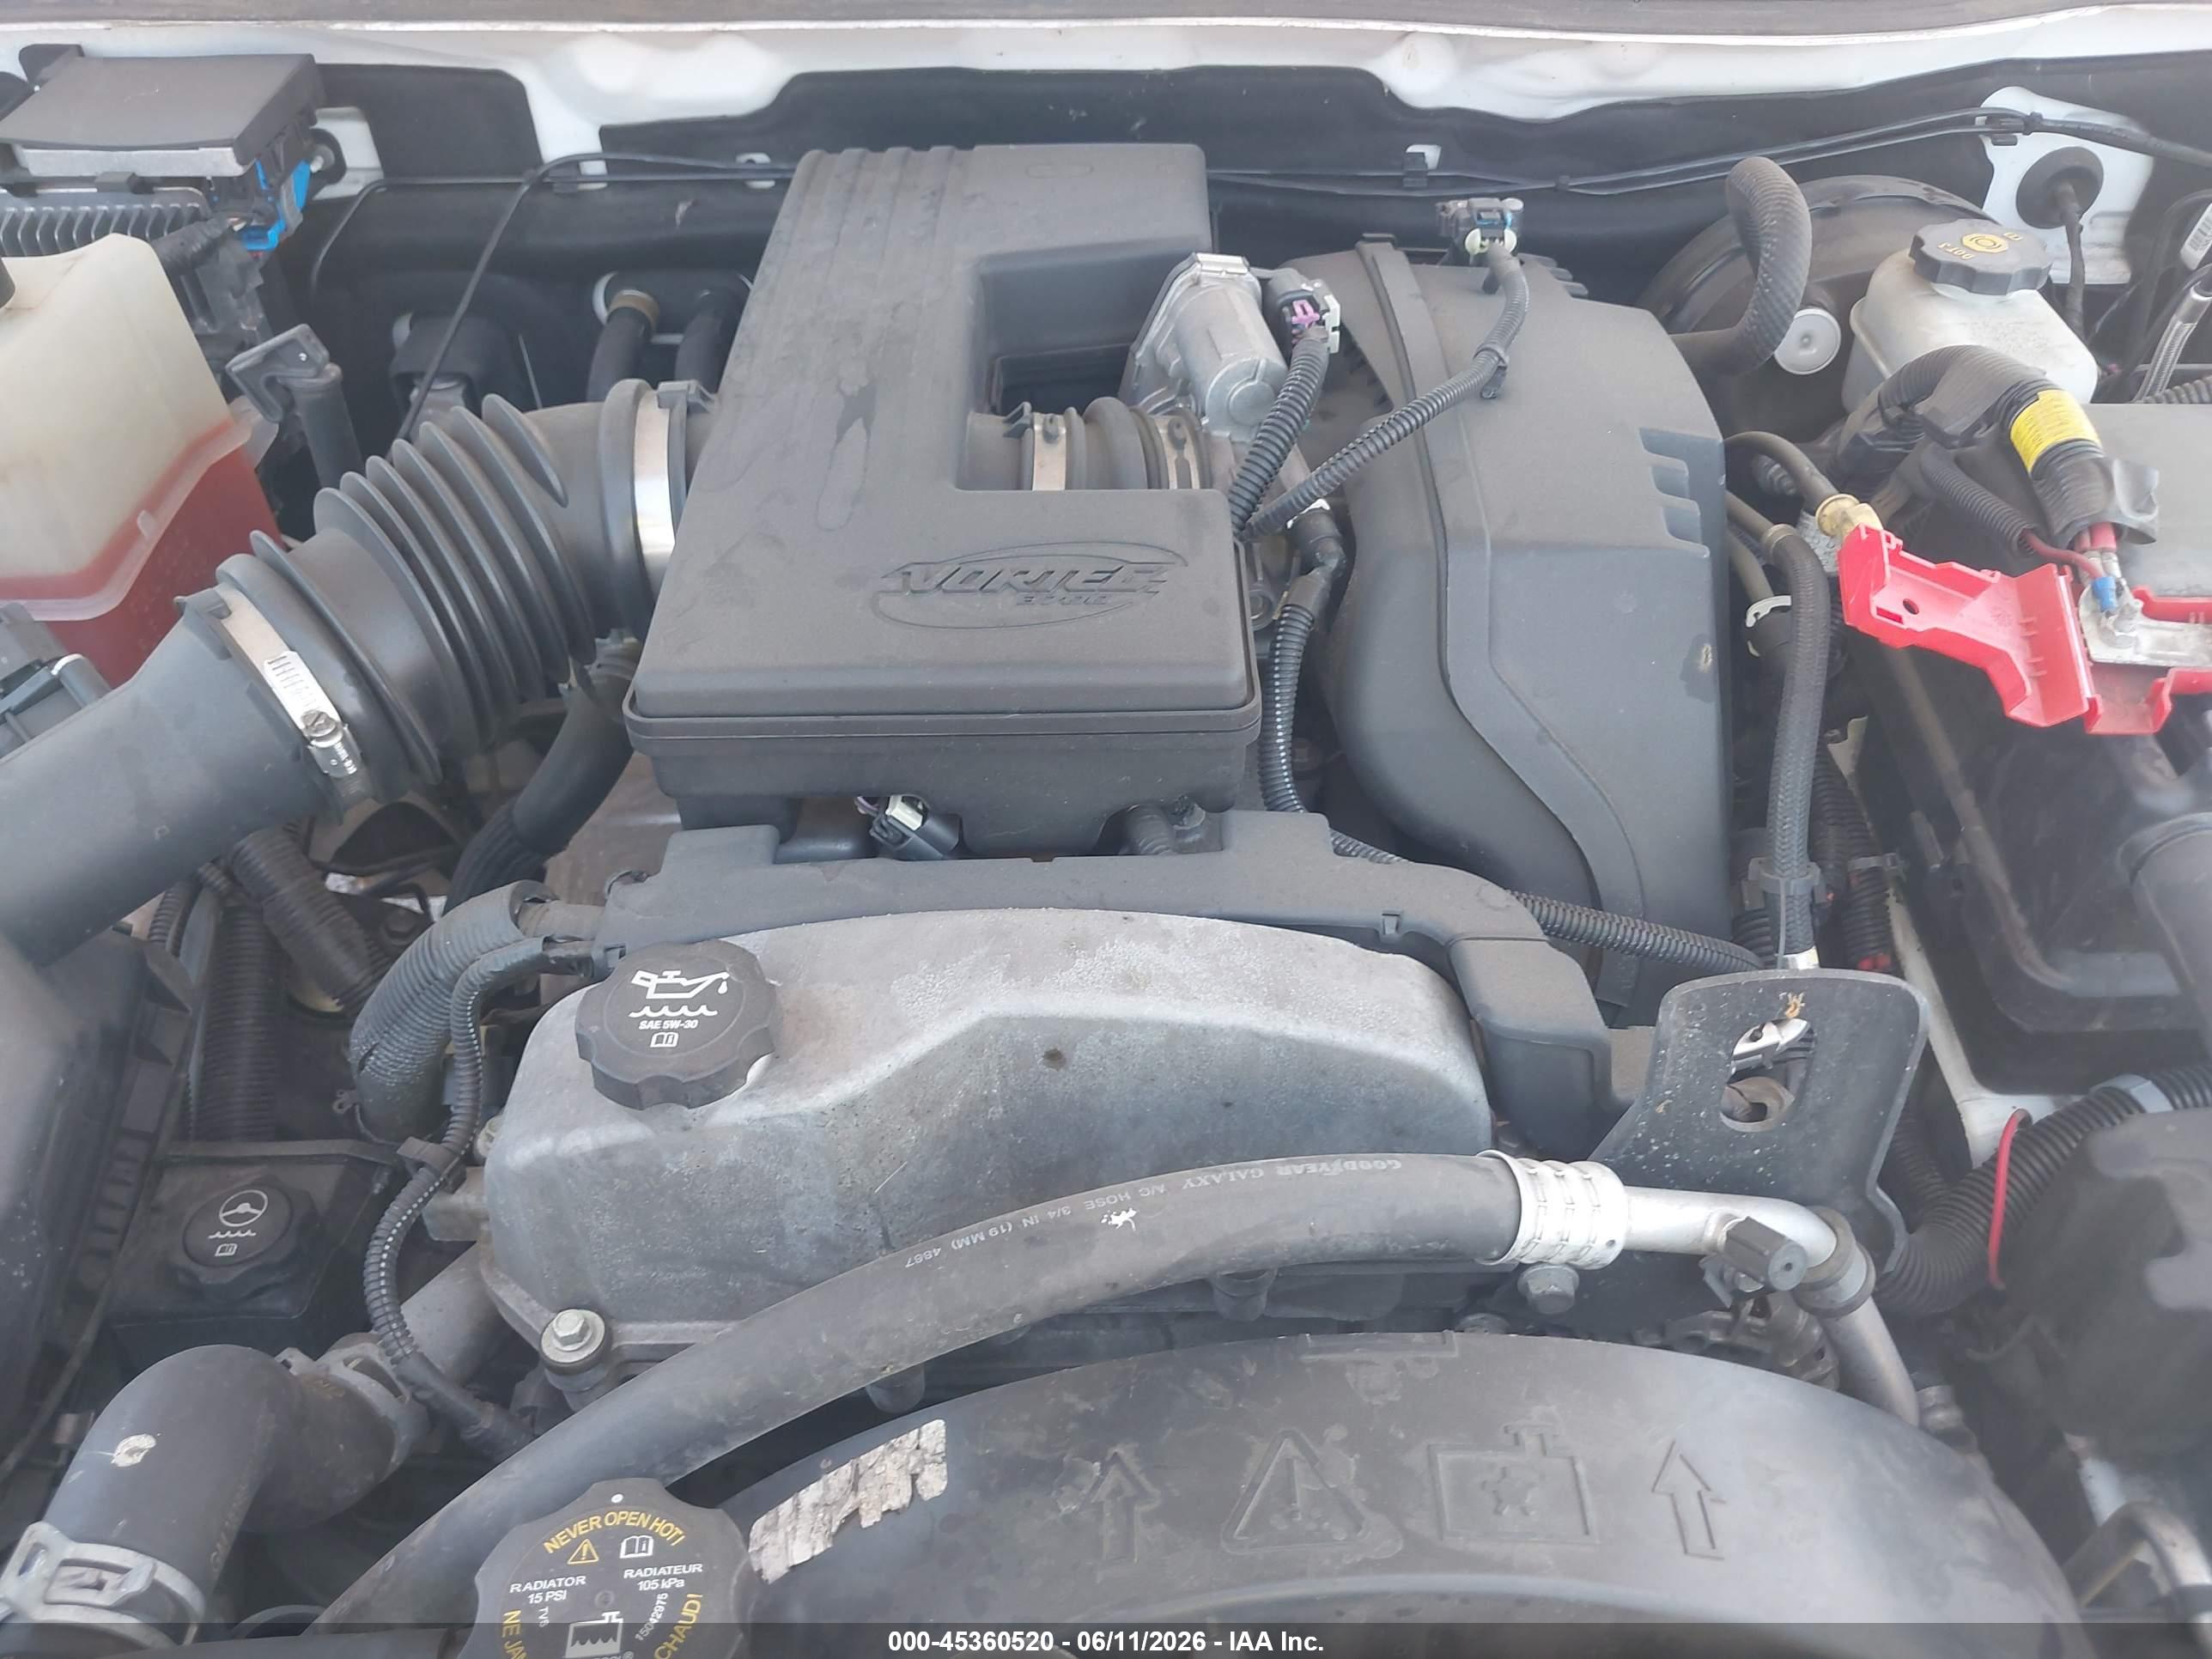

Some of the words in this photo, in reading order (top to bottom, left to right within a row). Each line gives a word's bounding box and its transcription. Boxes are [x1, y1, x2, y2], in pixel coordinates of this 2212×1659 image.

[638, 1020, 661, 1030] SAE
[662, 1018, 699, 1030] 5W-30
[1275, 1159, 1402, 1176] GOODYEAR
[1182, 1167, 1265, 1190] GALAXY
[1084, 1190, 1132, 1211] HOSE
[1047, 1205, 1072, 1219] 3/4
[1021, 1214, 1040, 1228] IN
[950, 1231, 987, 1251] MM)
[543, 1515, 603, 1554] NEVER
[604, 1510, 651, 1528] OPEN
[623, 1563, 703, 1579] RADIATEUR
[509, 1575, 587, 1594] RADIATOR
[637, 1578, 659, 1591] 105
[660, 1577, 685, 1589] kPa
[527, 1592, 544, 1604] 15
[544, 1589, 568, 1601] PSI
[501, 1608, 522, 1638] NE
